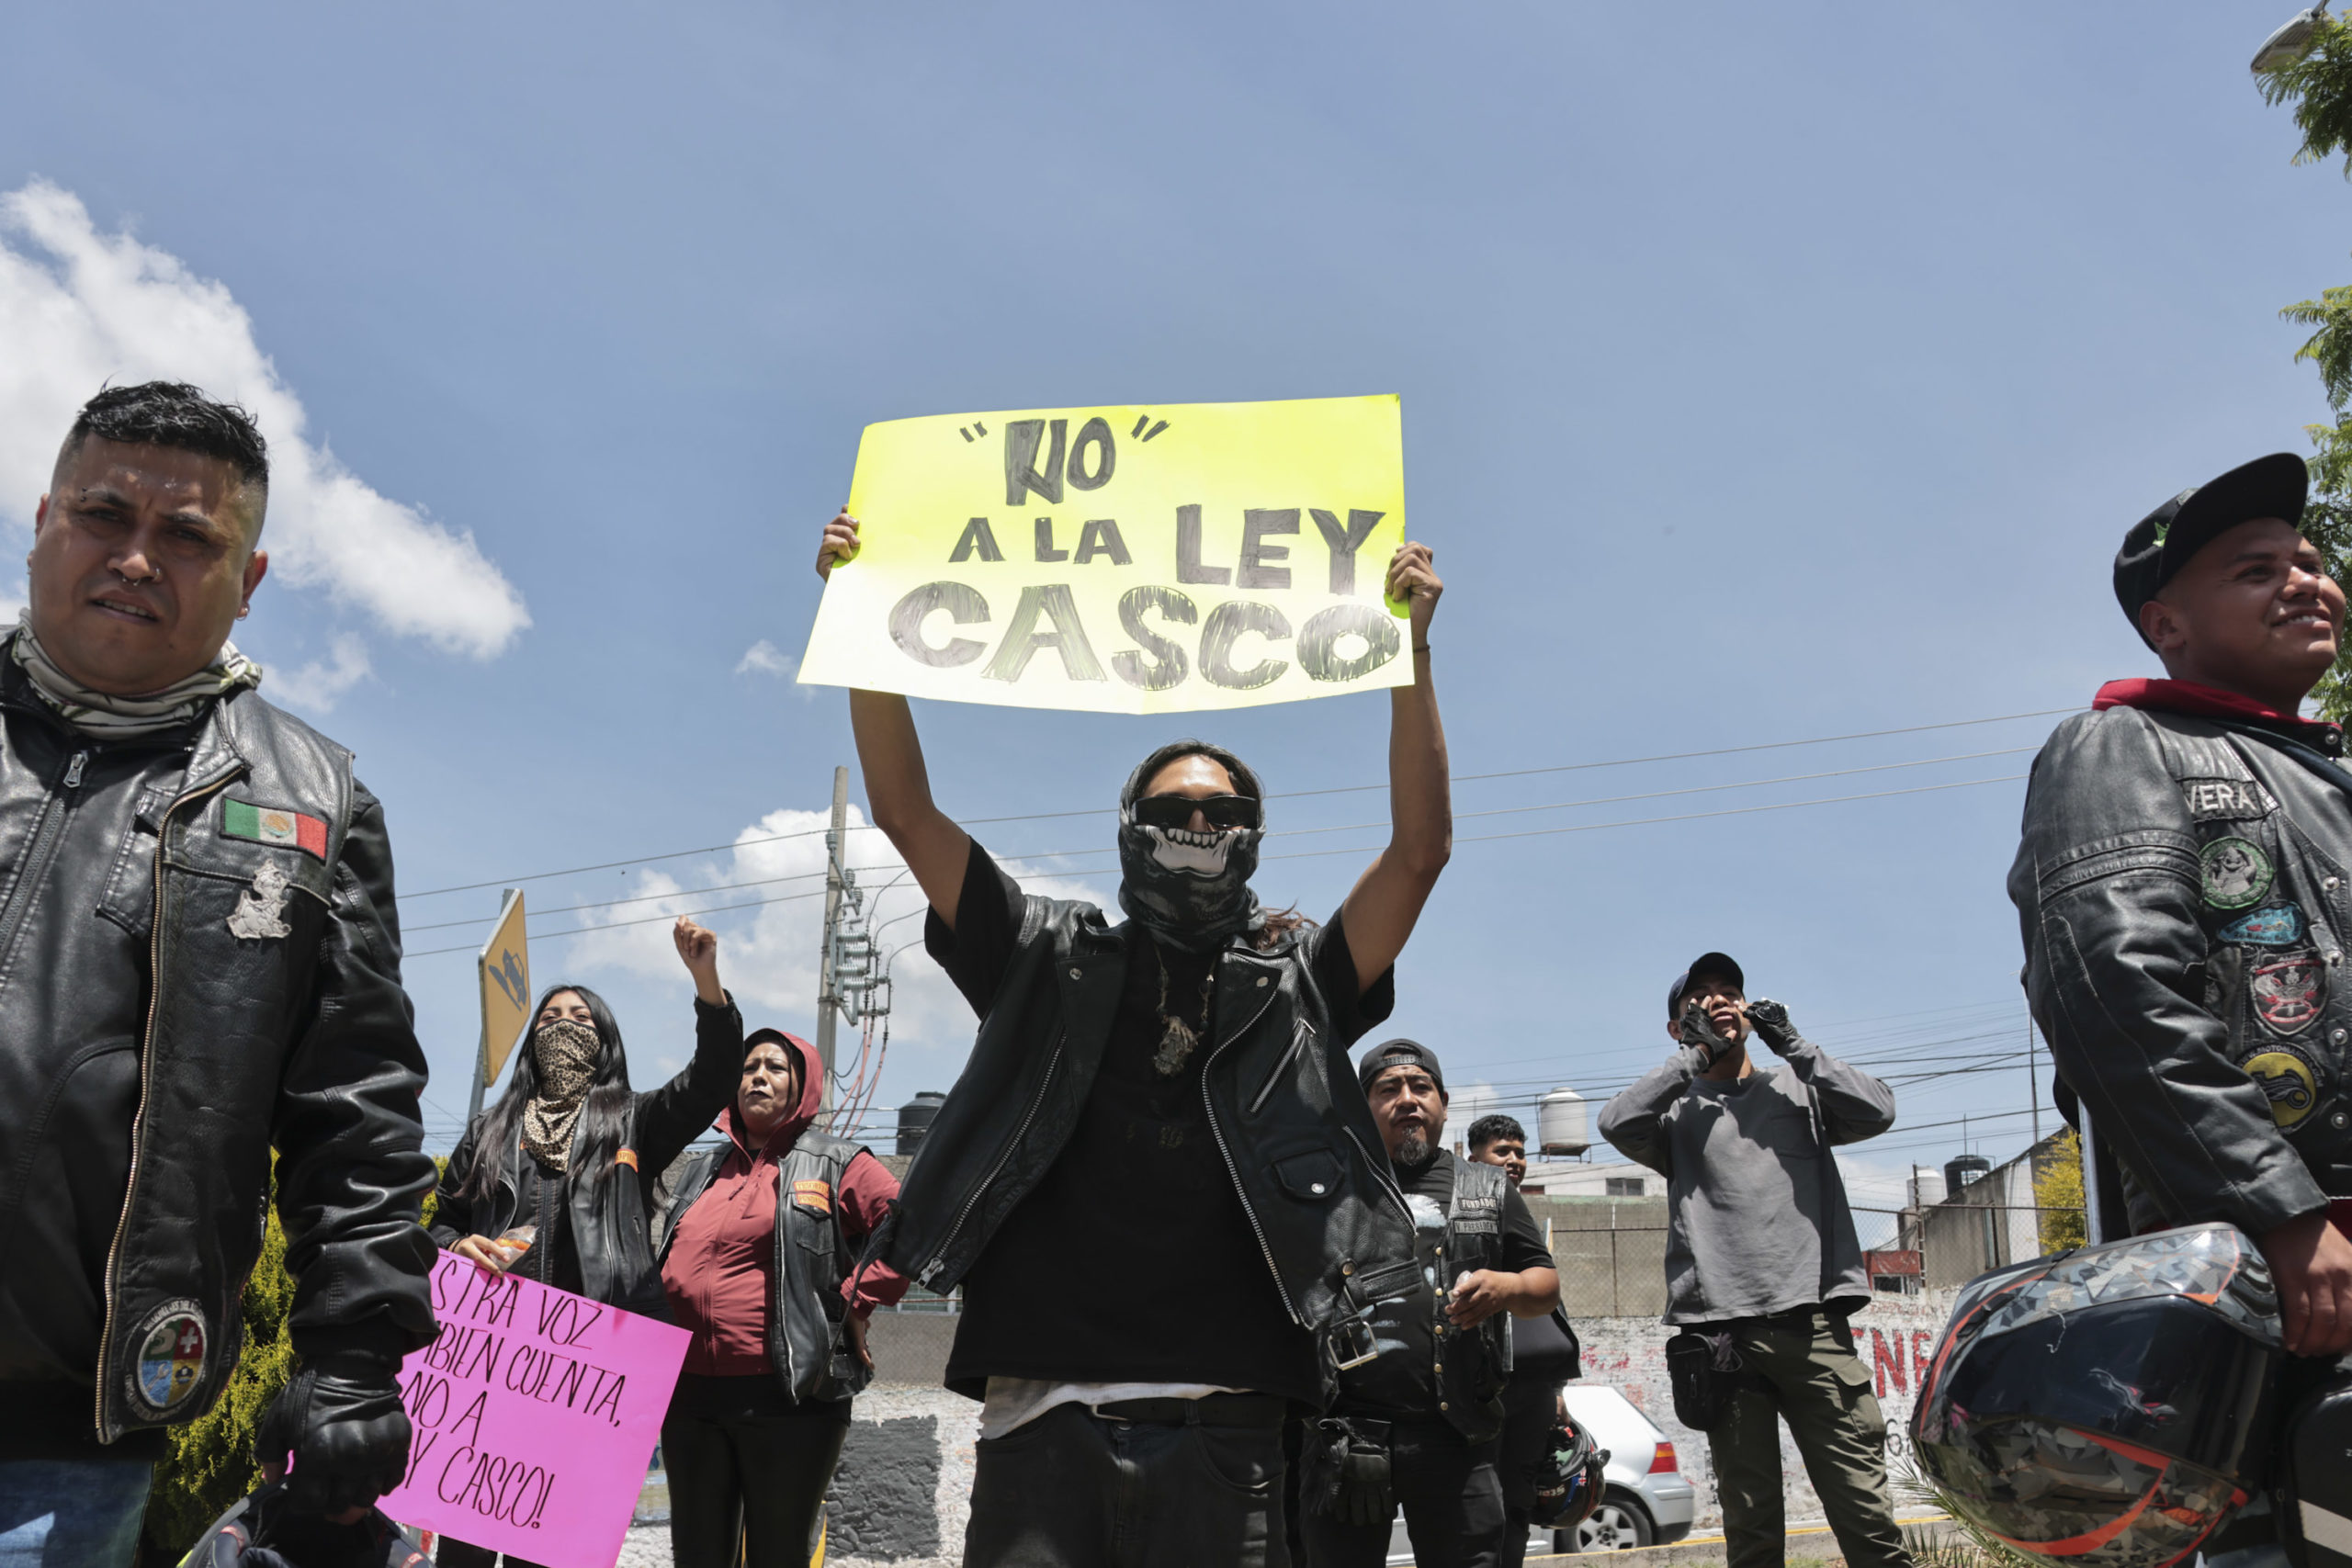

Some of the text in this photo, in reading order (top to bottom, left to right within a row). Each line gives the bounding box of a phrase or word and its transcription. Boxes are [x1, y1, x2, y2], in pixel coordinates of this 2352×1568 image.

[948, 503, 1387, 595] A LA LEY
[888, 581, 1401, 691] CASCO
[433, 1255, 603, 1349] STRA VOZ
[401, 1371, 488, 1447] NO A
[506, 1344, 627, 1427] CUENTA,
[404, 1428, 556, 1529] Y CASCO!
